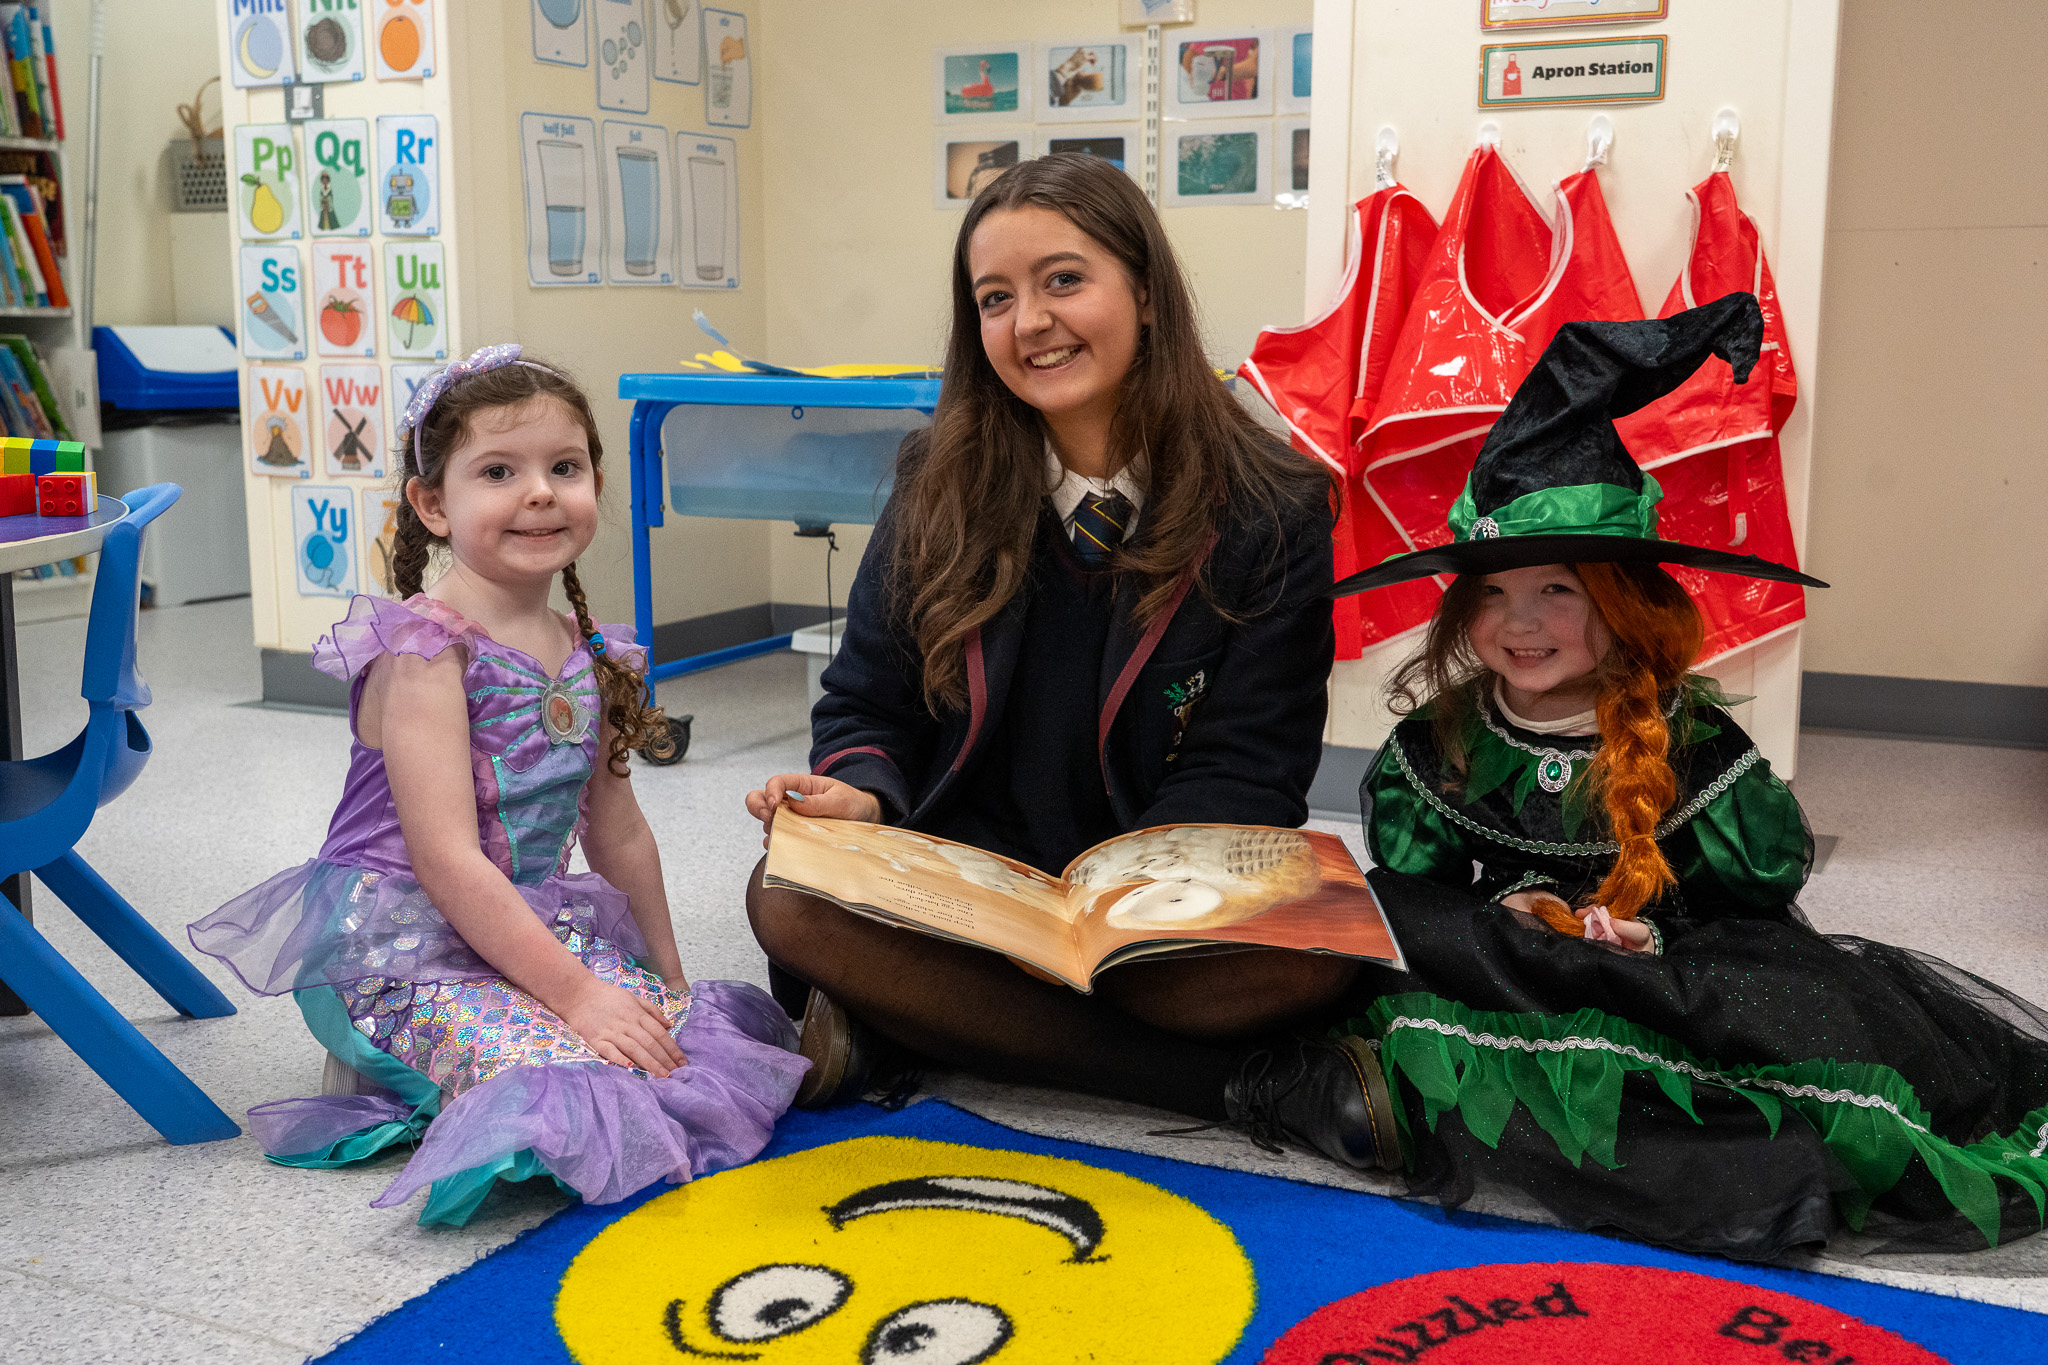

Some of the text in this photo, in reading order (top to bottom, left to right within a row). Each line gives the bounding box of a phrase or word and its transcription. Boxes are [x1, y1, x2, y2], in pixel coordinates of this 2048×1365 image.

[1532, 61, 1654, 81] Apron Station
[252, 137, 293, 182] Pp
[315, 131, 365, 177] Qq
[396, 129, 433, 165] Rr
[261, 258, 297, 293] Ss
[331, 254, 367, 289] Tt
[396, 254, 441, 290] Uu
[260, 377, 303, 414] Vv
[325, 378, 380, 406] Ww
[307, 498, 348, 544] Yy
[1717, 1305, 1854, 1365] Be
